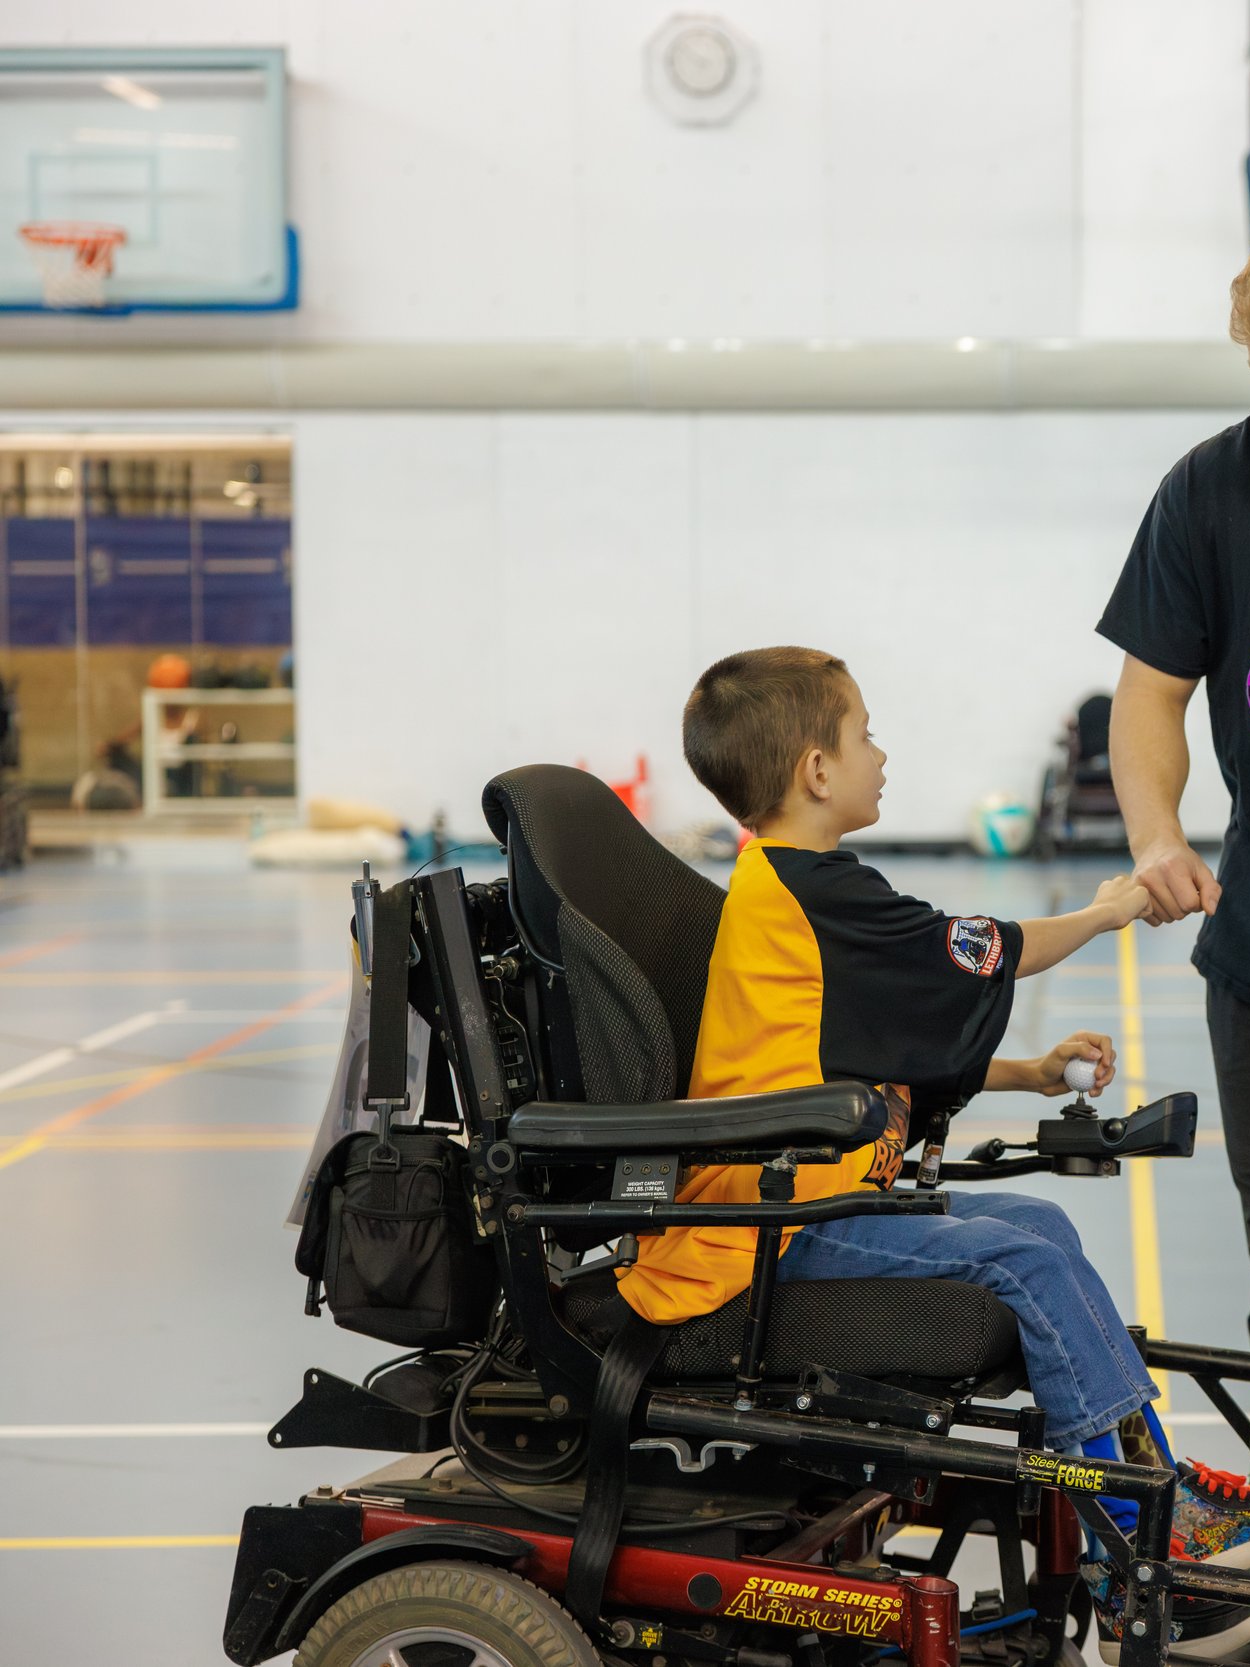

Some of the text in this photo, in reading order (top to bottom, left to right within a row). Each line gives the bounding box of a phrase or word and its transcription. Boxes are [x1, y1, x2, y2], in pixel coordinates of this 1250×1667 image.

[981, 923, 1002, 975] LETHBRI
[1026, 1455, 1104, 1491] Steel FORCE
[744, 1576, 819, 1599] STORM
